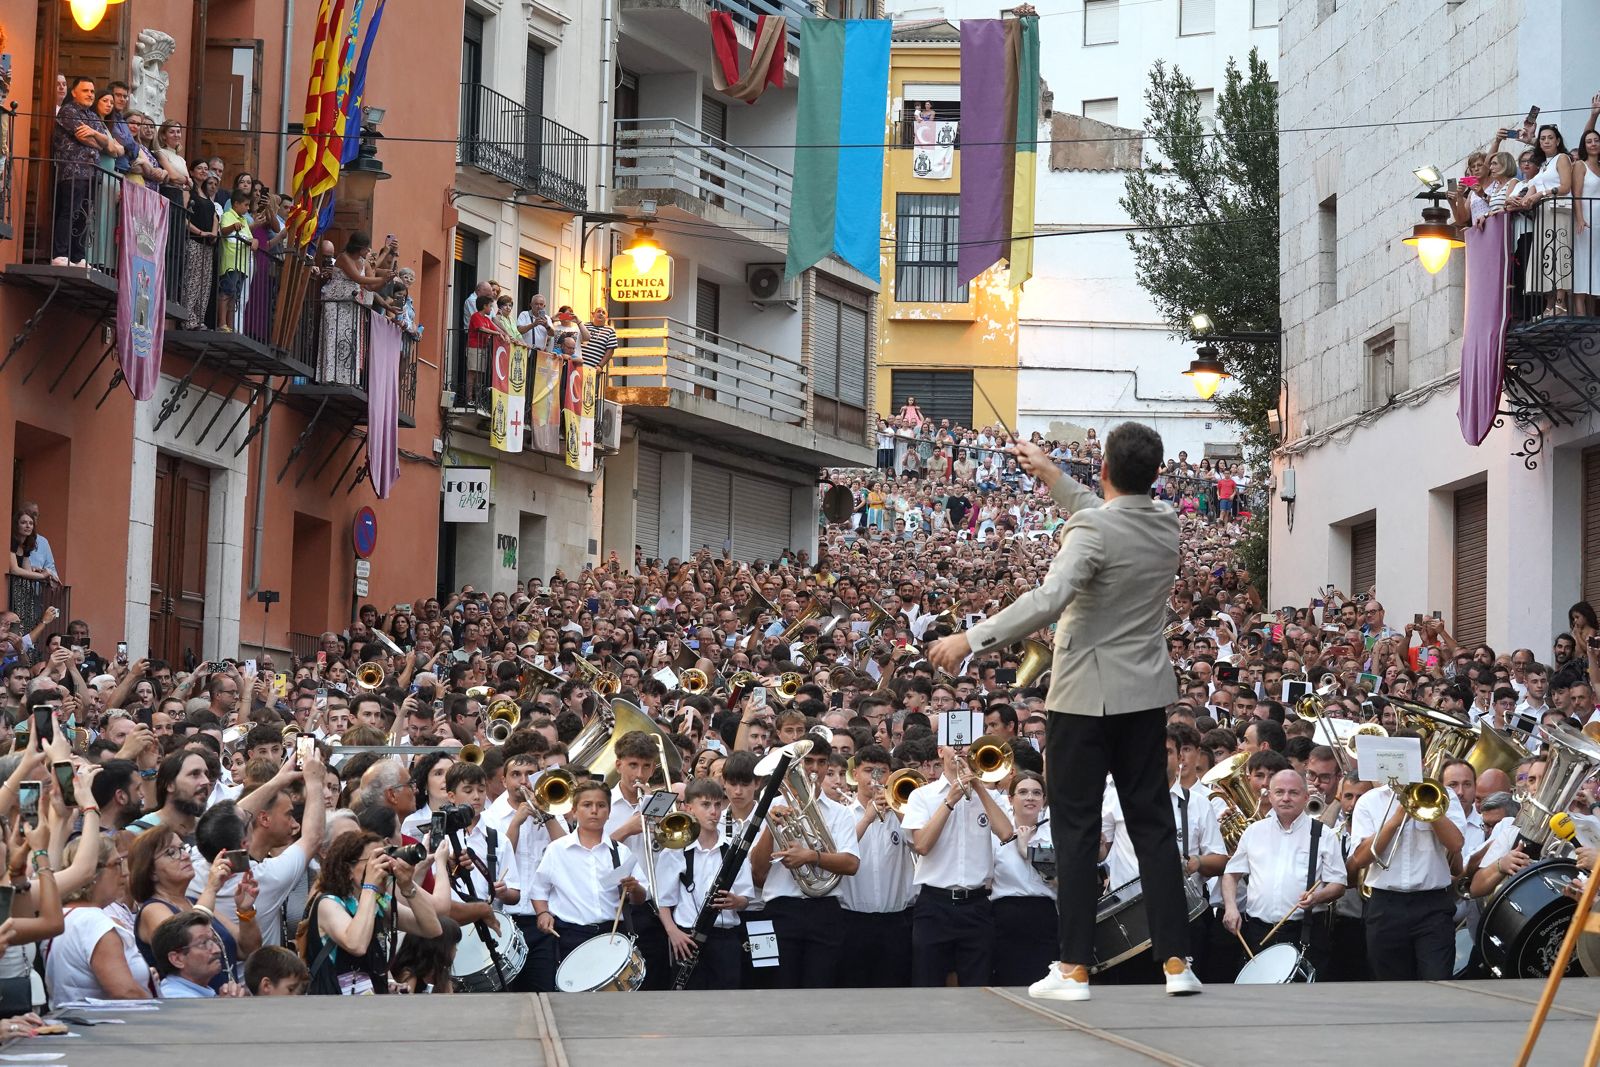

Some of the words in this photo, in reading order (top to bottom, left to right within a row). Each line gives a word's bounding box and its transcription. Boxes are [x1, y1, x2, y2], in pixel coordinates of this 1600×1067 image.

[615, 279, 664, 287] CLINICA
[618, 290, 661, 298] DENTAL
[447, 481, 488, 493] FOTO
[477, 498, 487, 509] 2
[498, 533, 517, 550] FOTO
